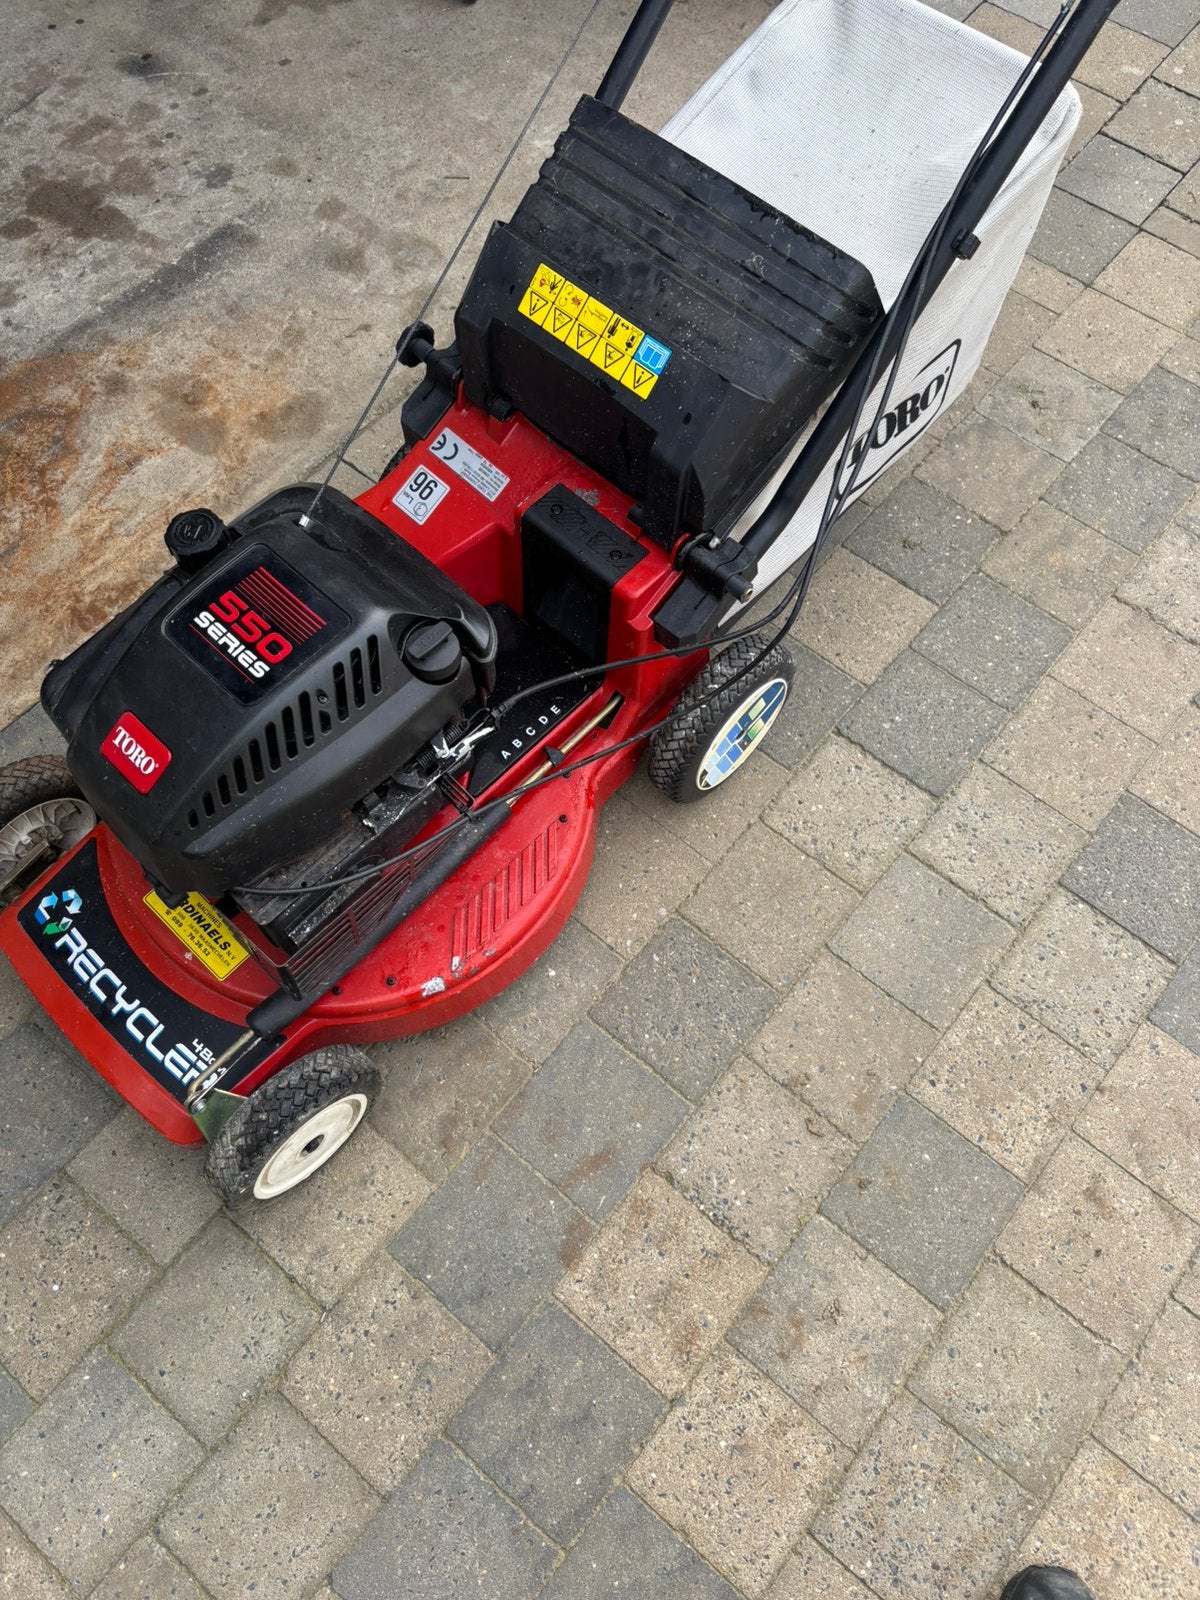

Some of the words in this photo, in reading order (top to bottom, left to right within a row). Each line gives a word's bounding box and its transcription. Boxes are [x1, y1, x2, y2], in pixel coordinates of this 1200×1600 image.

[409, 472, 438, 500] 96
[193, 611, 270, 678] SERIES
[208, 590, 293, 664] 550
[112, 726, 156, 775] TORO
[501, 750, 511, 760] A
[512, 738, 523, 749] B
[525, 726, 536, 736] C
[538, 715, 549, 725] D
[550, 704, 561, 715] E
[181, 899, 231, 951] RDINAELS
[197, 902, 223, 929] MACHINES
[54, 927, 218, 1090] RECYCLER
